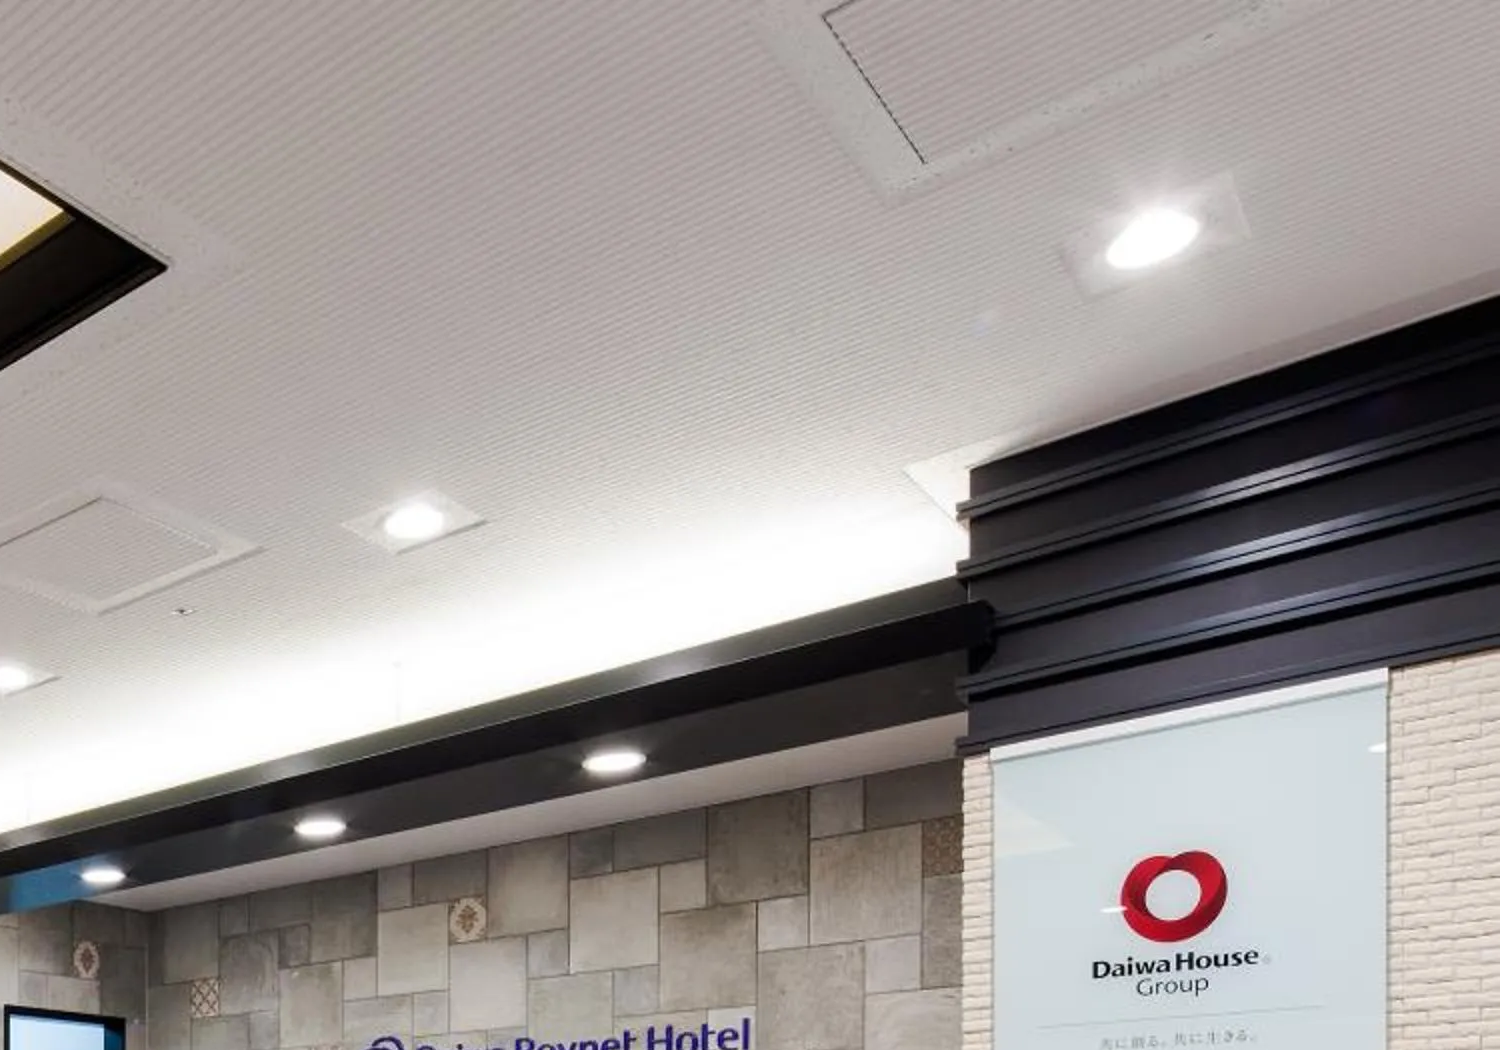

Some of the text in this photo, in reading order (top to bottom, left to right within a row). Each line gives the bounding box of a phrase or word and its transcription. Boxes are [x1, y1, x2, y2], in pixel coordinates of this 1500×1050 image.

[1092, 950, 1259, 979] Daiwa House
[1136, 977, 1209, 996] Group
